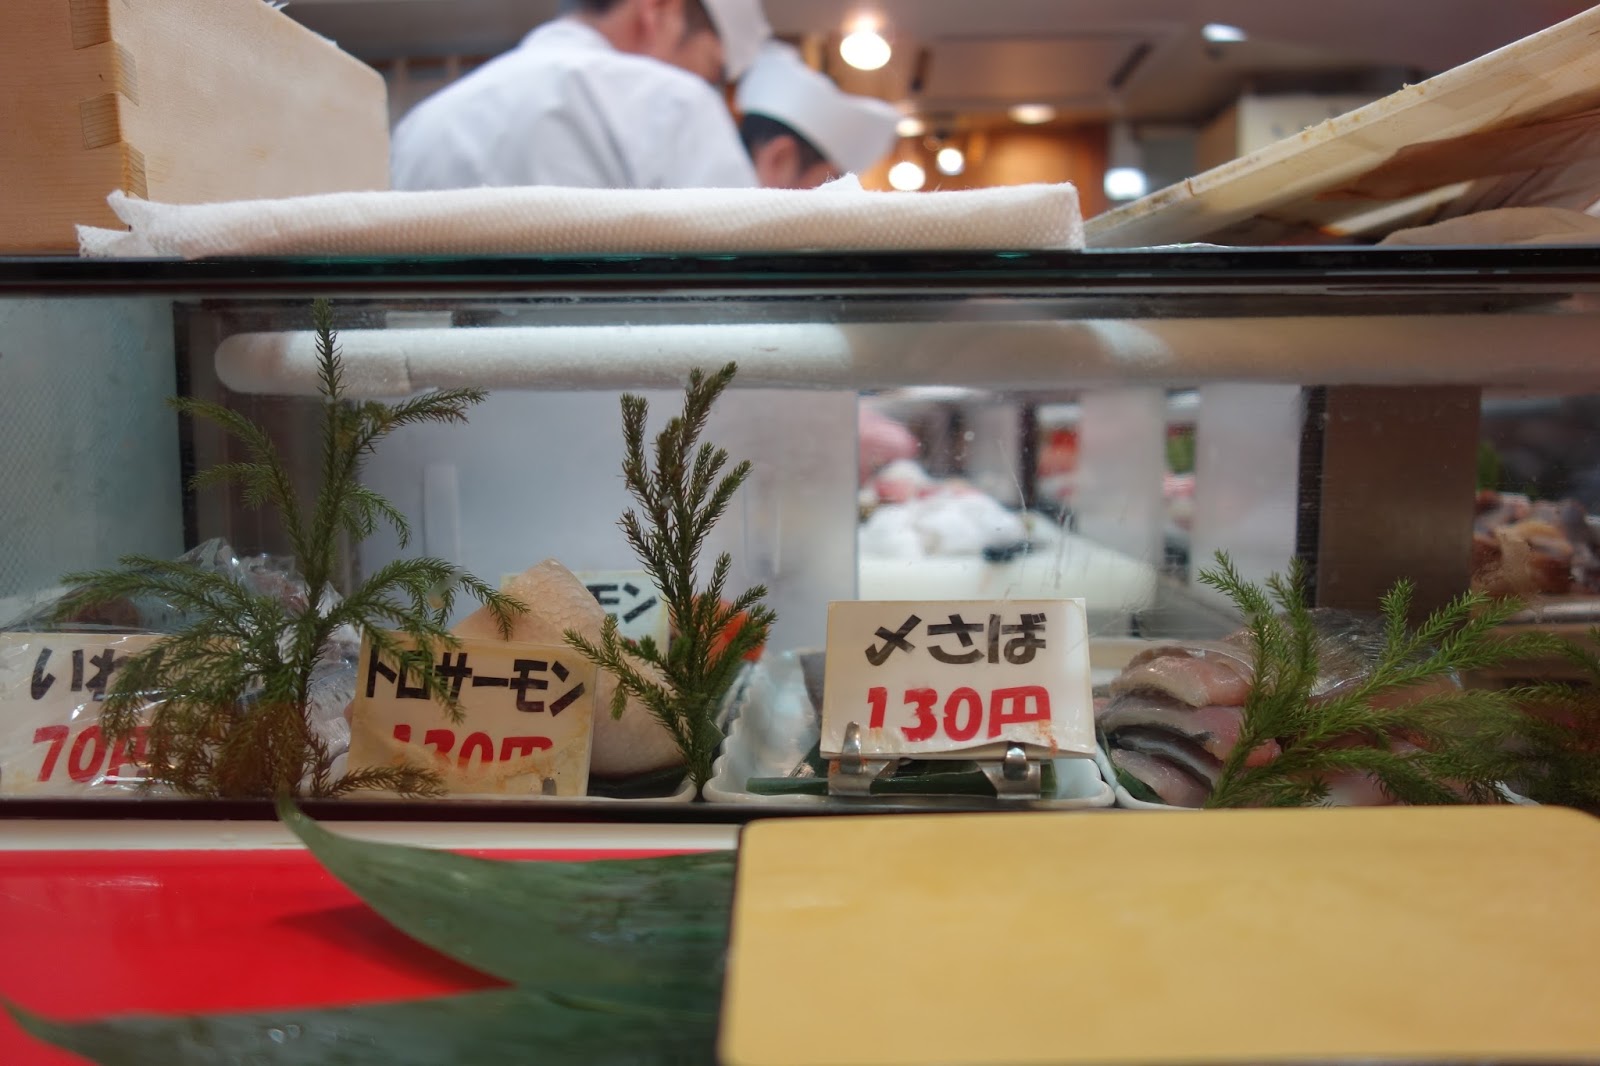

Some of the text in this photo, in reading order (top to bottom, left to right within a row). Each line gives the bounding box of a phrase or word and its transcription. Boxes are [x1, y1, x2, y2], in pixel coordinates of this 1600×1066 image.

[365, 645, 586, 717] トロサーモン
[867, 686, 1051, 742] 130円
